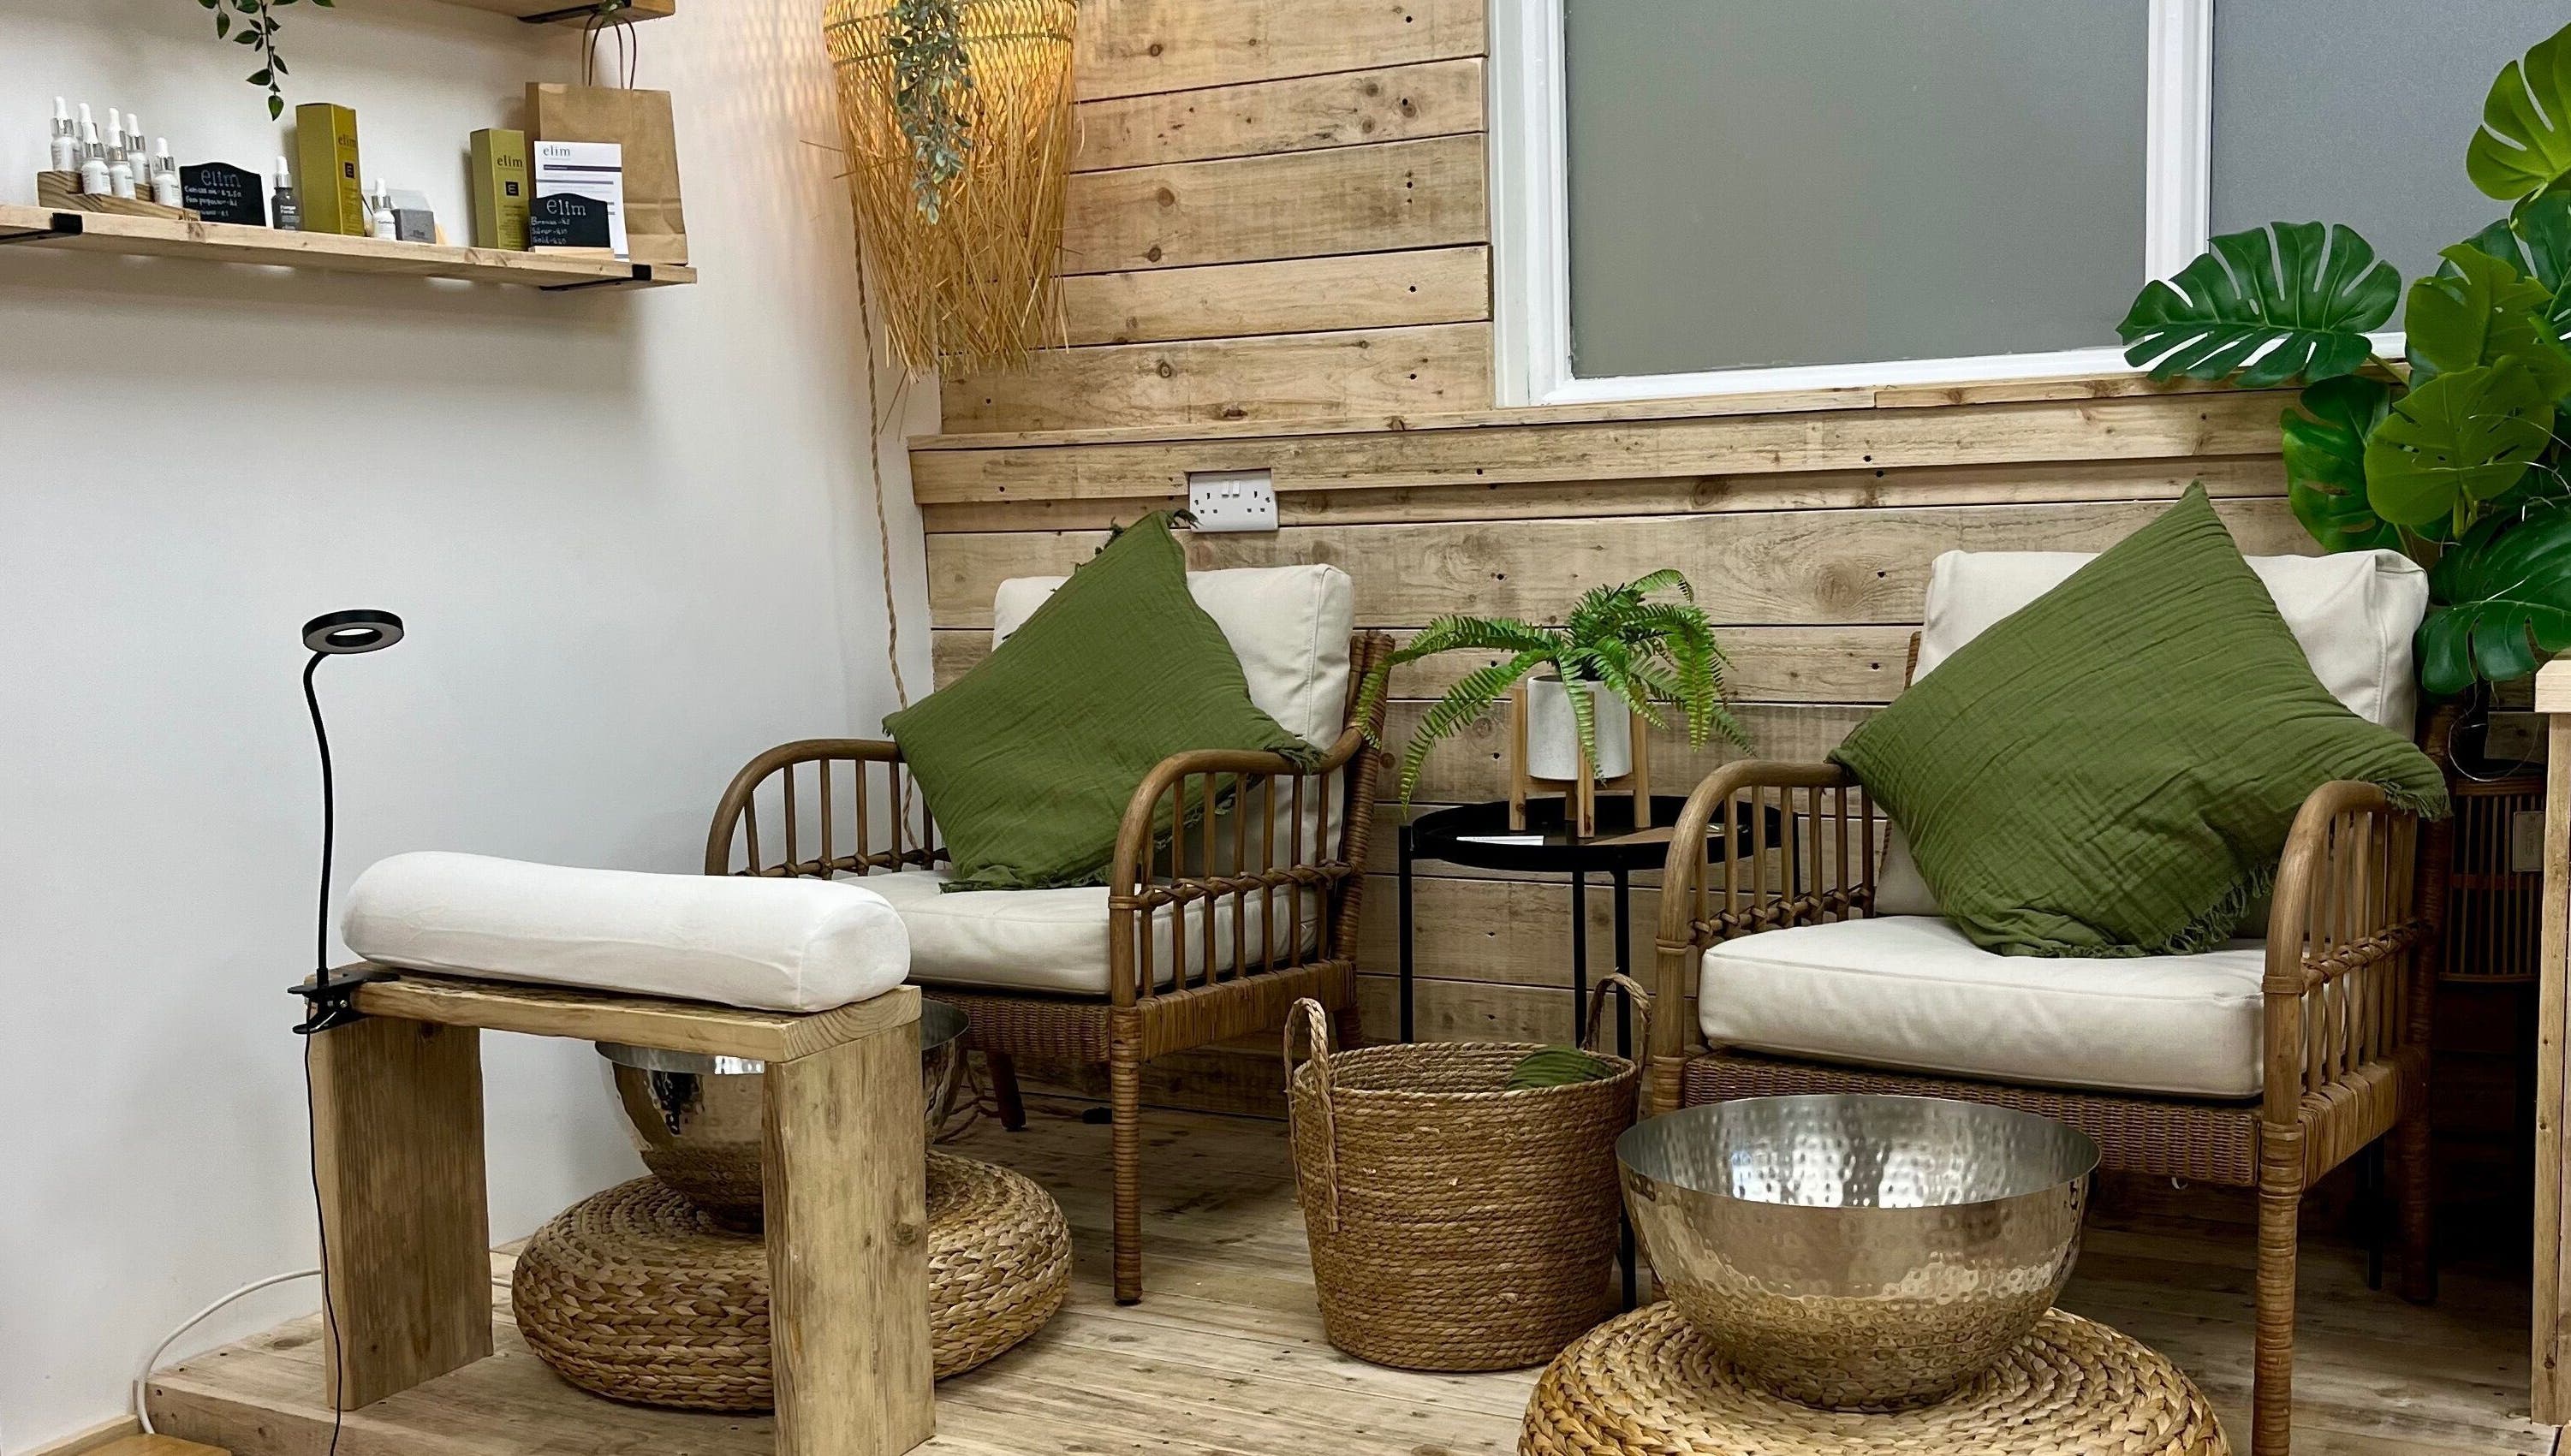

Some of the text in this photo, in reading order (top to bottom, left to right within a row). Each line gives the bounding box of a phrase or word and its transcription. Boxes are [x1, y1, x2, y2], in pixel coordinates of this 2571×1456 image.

[544, 146, 570, 156] elim
[497, 155, 523, 168] elim
[200, 169, 241, 187] elim
[546, 199, 586, 216] elim
